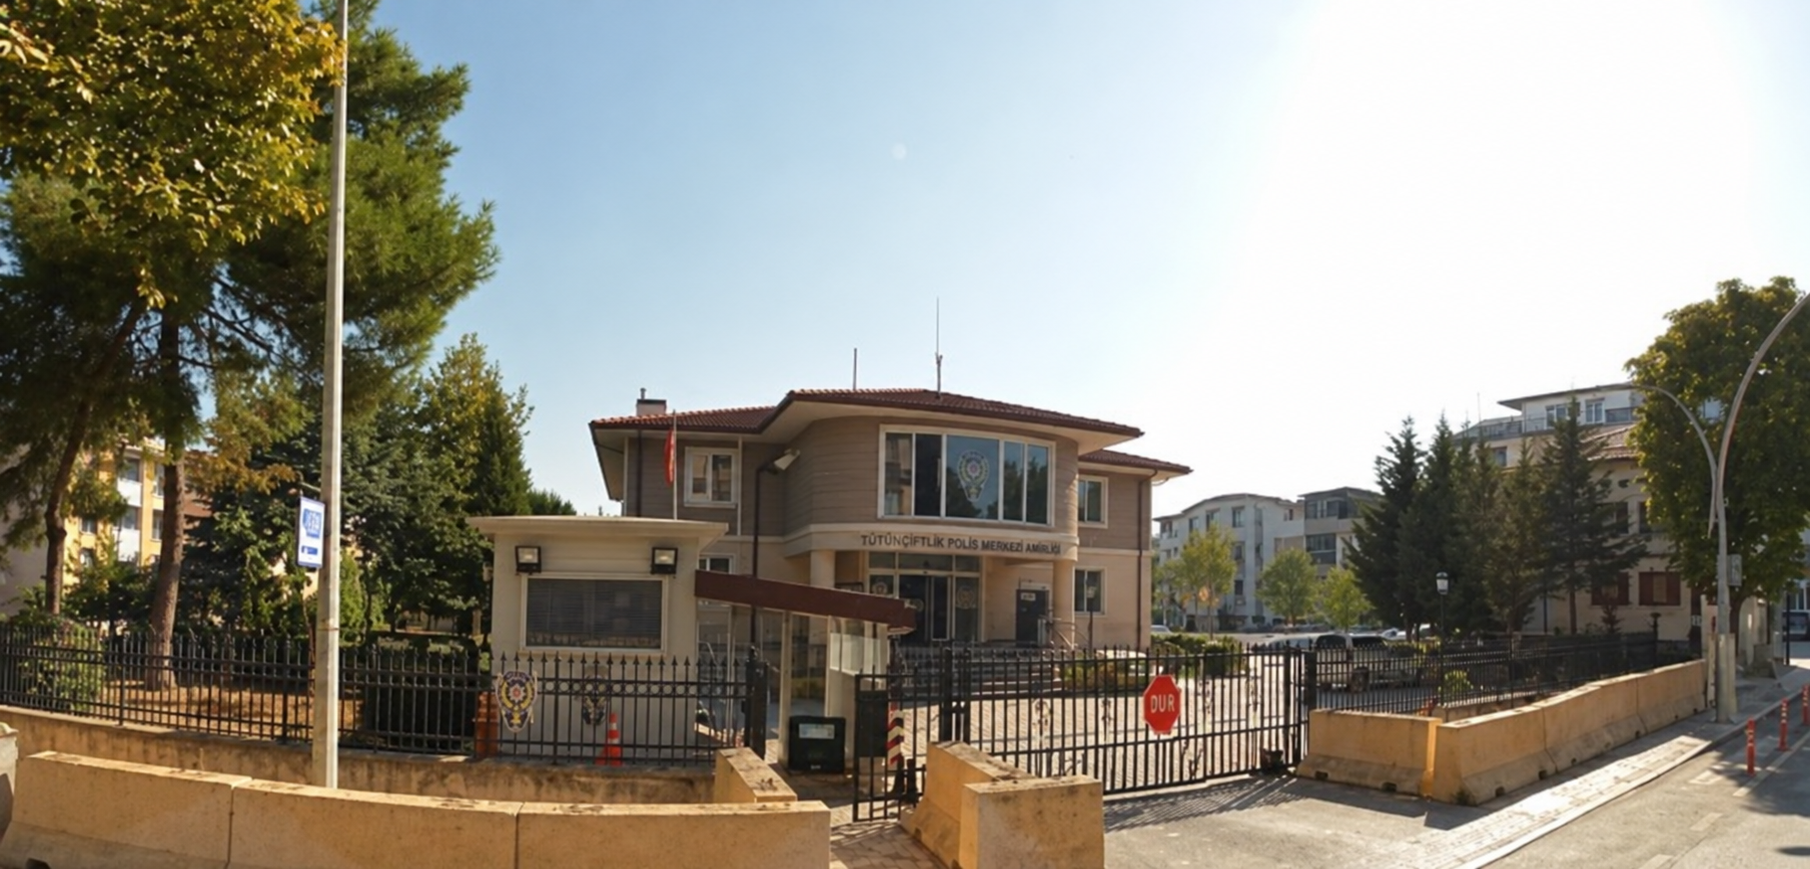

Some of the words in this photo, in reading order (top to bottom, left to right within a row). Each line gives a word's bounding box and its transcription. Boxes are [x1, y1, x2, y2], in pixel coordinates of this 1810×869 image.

[861, 532, 944, 548] TÜTÜNÇİFTLİK
[947, 536, 979, 550] POLİS
[981, 539, 1024, 553] MERKEZİ
[1150, 693, 1175, 713] DUR
